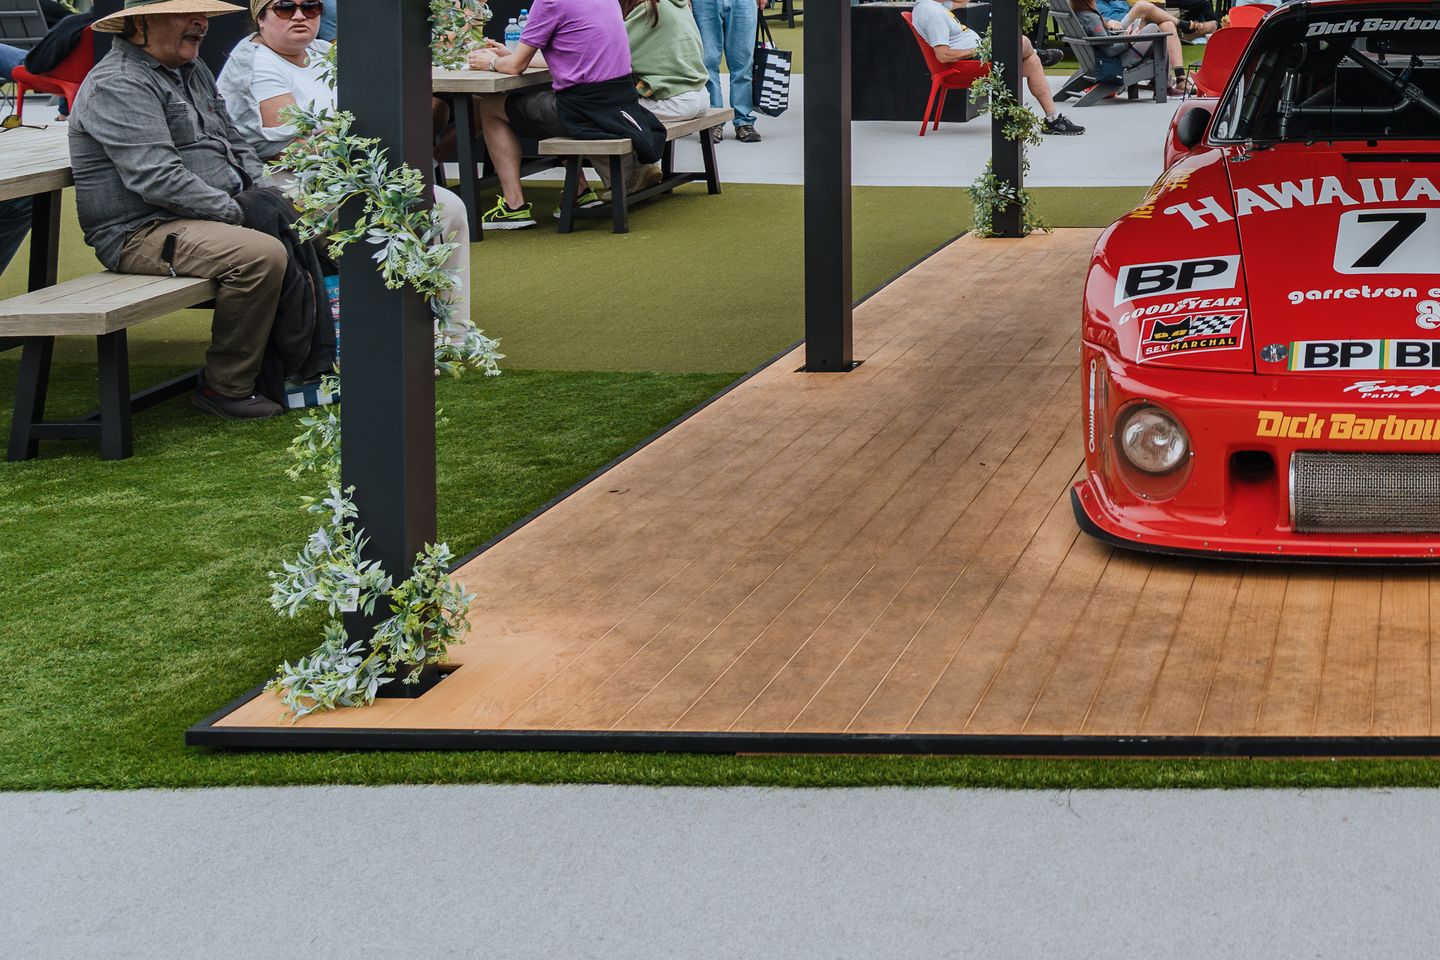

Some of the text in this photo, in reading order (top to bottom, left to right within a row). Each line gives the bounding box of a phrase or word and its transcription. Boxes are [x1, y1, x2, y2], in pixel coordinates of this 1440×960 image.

[1306, 20, 1359, 37] Dick
[1125, 259, 1229, 297] BP
[1288, 286, 1417, 304] garretson
[1170, 338, 1235, 351] MARCHAL
[1304, 342, 1373, 368] BP
[1256, 410, 1323, 439] Dick
